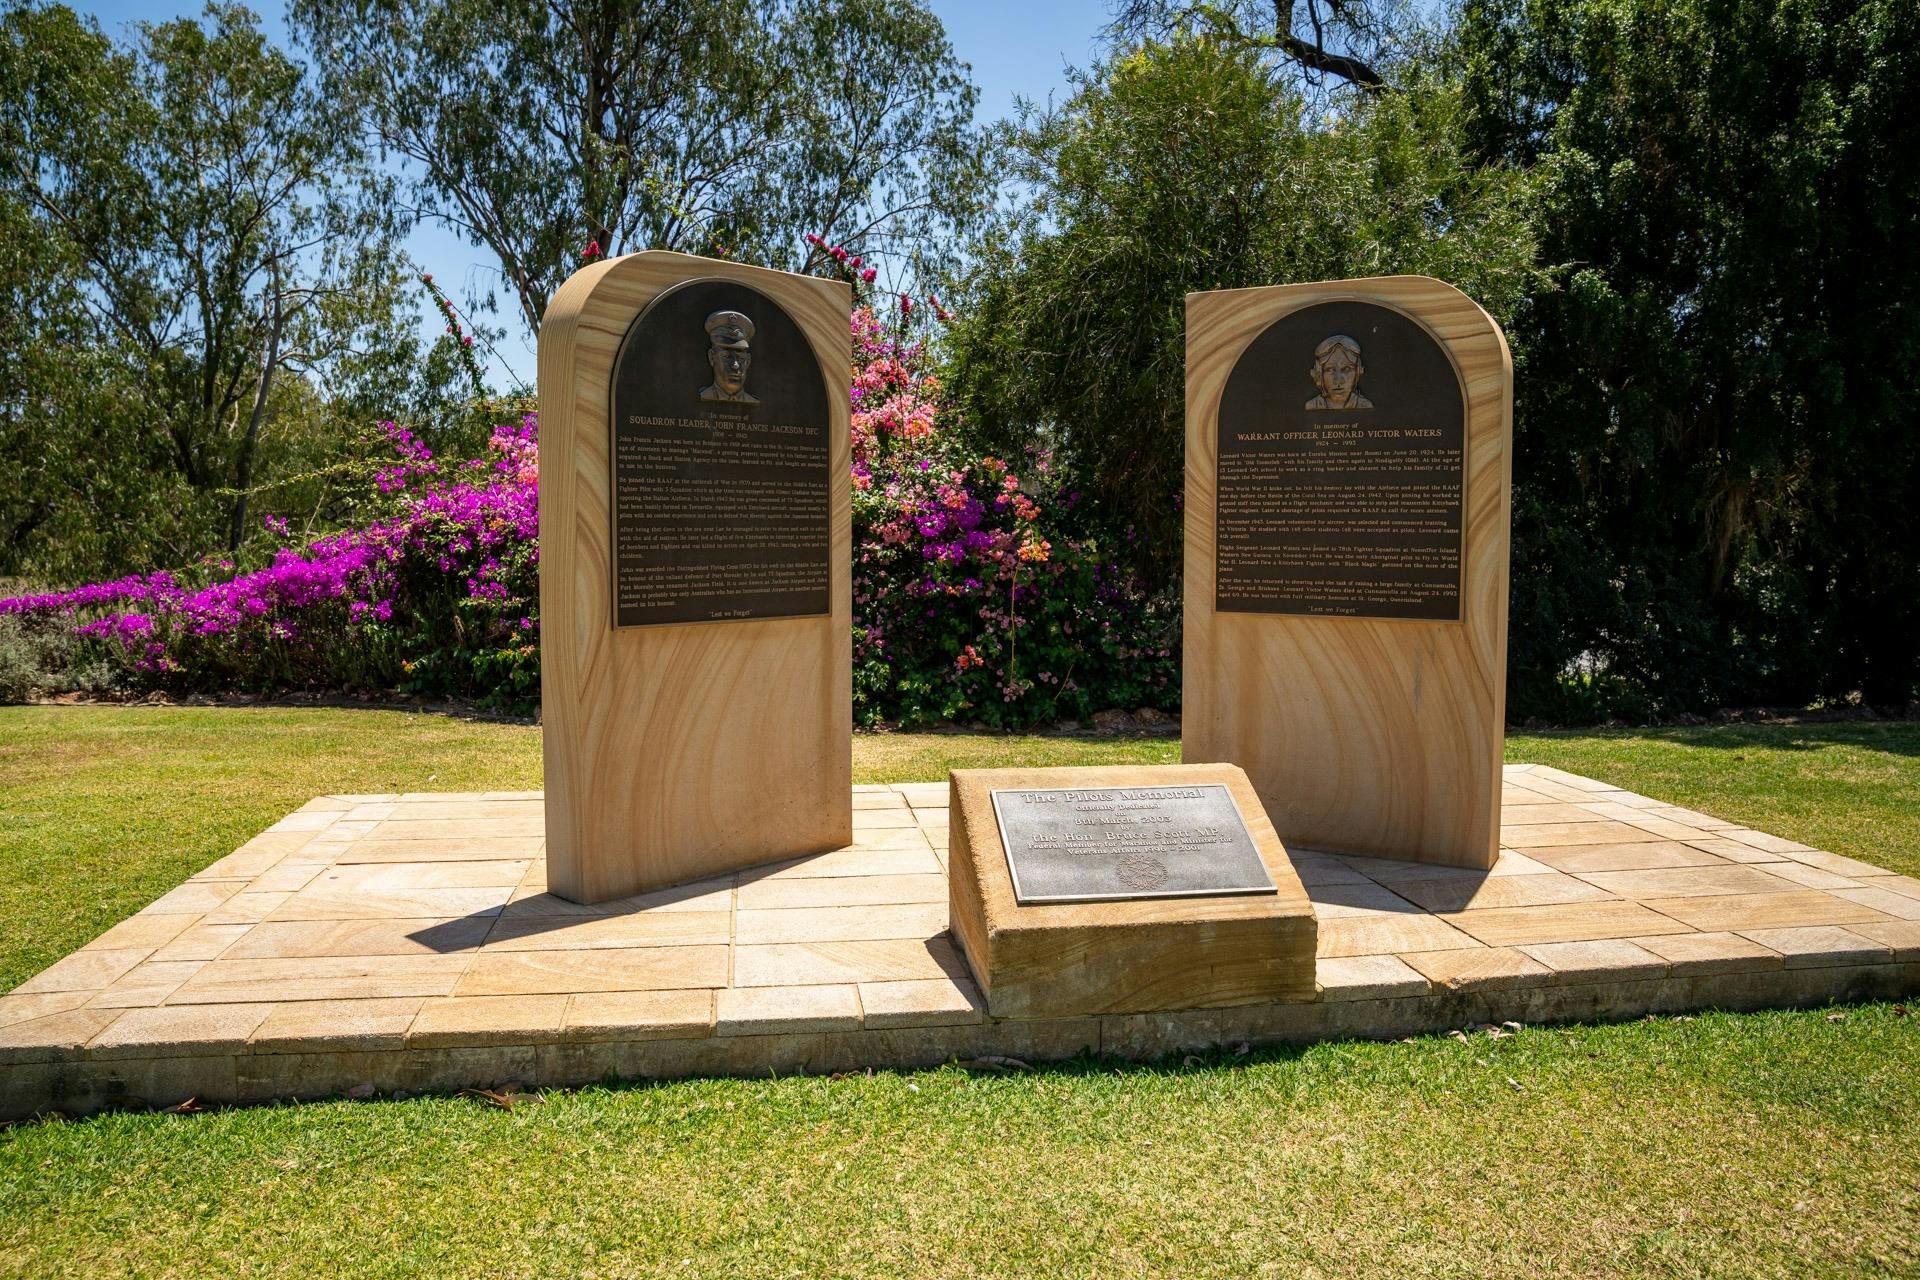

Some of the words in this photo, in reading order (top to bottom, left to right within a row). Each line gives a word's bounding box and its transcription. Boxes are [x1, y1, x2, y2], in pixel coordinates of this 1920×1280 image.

[630, 416, 675, 426] SQUADRON
[715, 421, 734, 430] JOHN
[737, 423, 769, 432] FRANCIS
[771, 425, 803, 434] JACKSON
[1237, 433, 1280, 441] WARRANT
[1284, 432, 1318, 440] OFFICER
[1322, 431, 1364, 439] LEONARD
[1368, 430, 1400, 438] VICTOR
[1404, 429, 1442, 437] WATERS
[1022, 793, 1056, 803] The
[1064, 792, 1114, 802] Pilots
[1120, 788, 1205, 800] Memorial
[1141, 816, 1172, 824] 2003
[1033, 834, 1057, 842] the
[1105, 832, 1147, 840] Bruce
